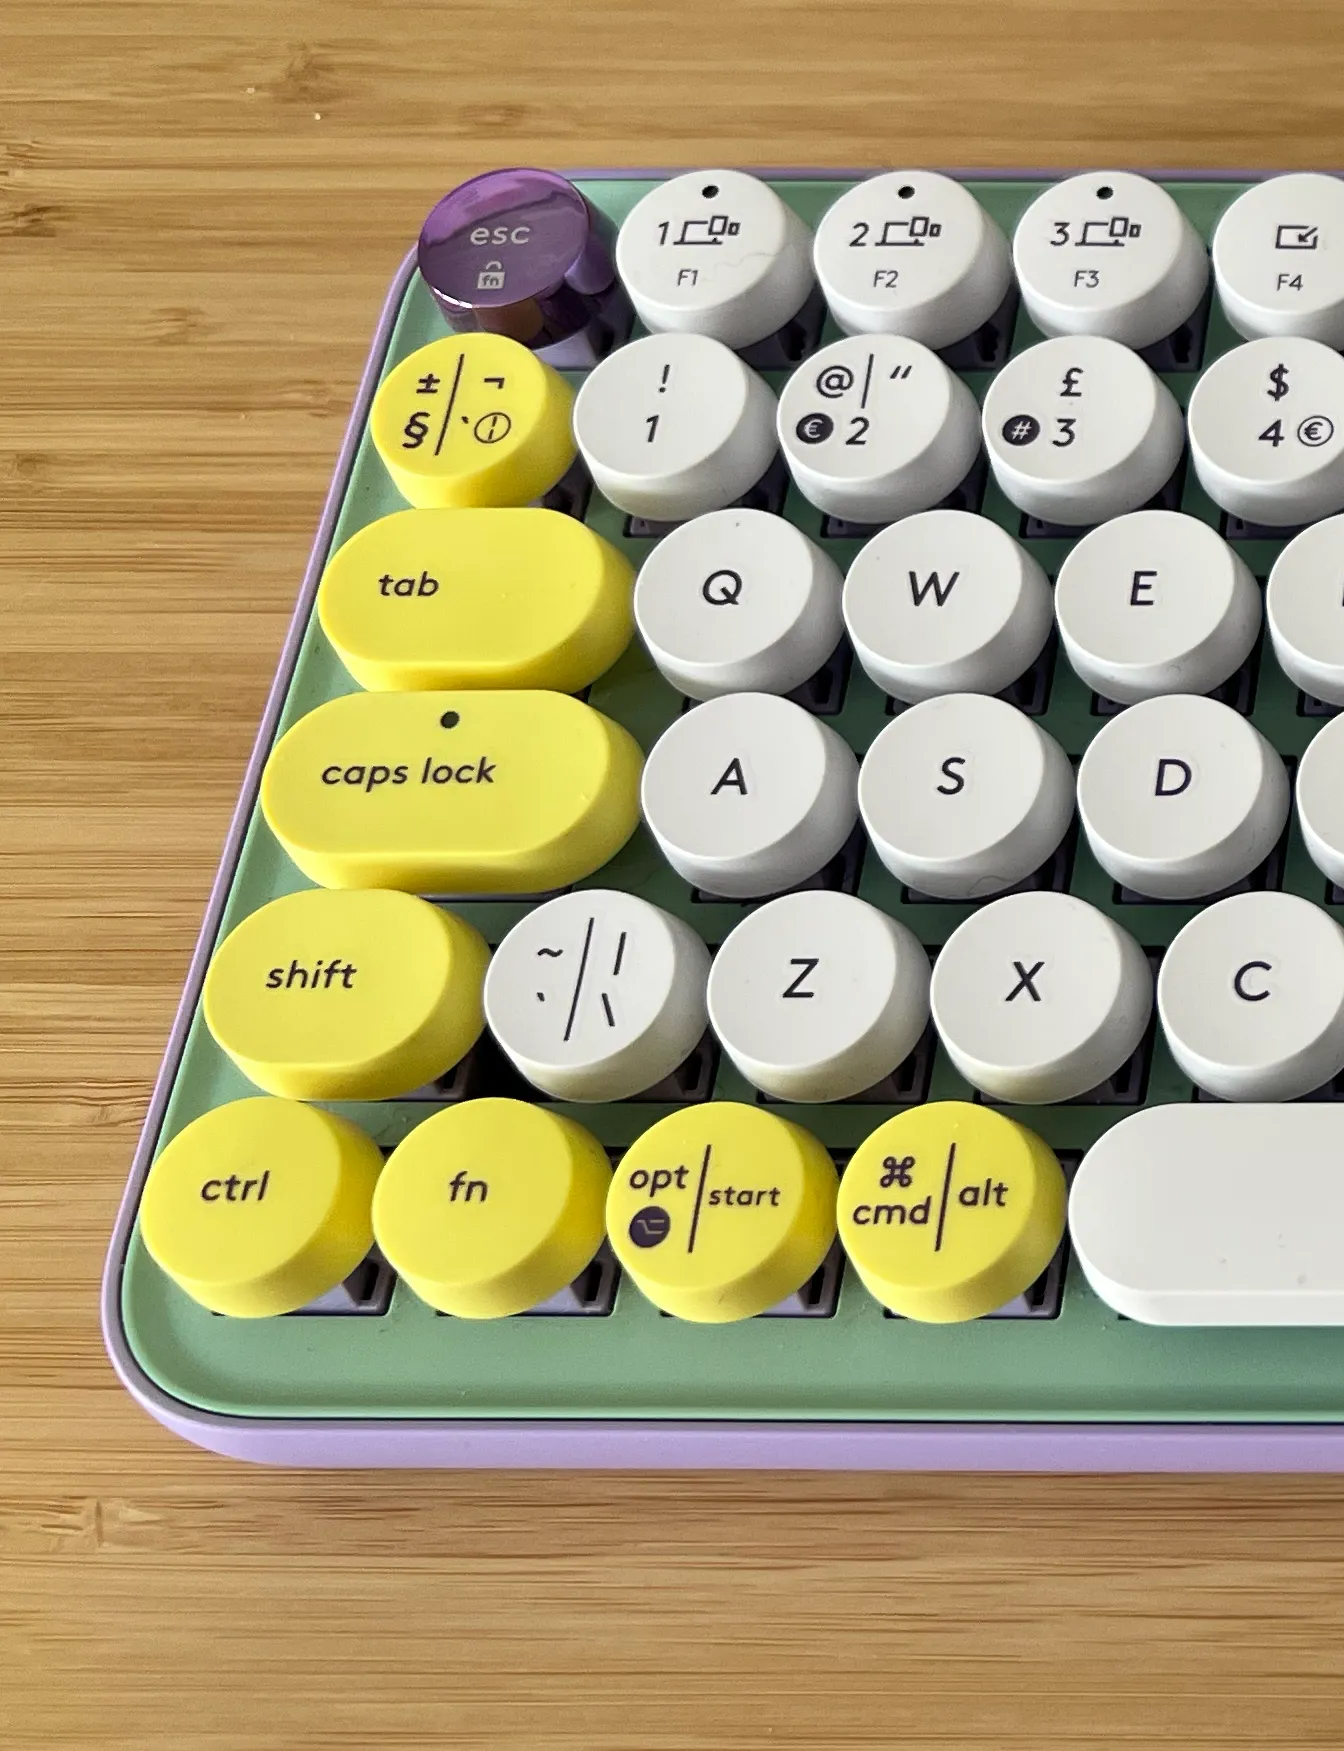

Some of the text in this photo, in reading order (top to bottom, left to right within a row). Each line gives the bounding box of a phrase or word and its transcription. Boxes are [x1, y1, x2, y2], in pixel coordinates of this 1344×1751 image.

[470, 226, 530, 246] esc
[658, 221, 670, 246] 1
[848, 222, 870, 247] 2
[1049, 221, 1070, 247] 3
[481, 273, 500, 287] fn
[677, 268, 699, 287] F1
[873, 269, 899, 289] F2
[1073, 269, 1100, 289] F3
[1276, 273, 1304, 292] F4
[646, 414, 660, 443] 1
[845, 416, 870, 446] 2
[1052, 418, 1077, 448] 3
[1258, 419, 1285, 448] 4
[378, 570, 439, 597] tab
[701, 569, 743, 606] Q
[908, 570, 960, 607] W
[1129, 570, 1158, 607] E
[321, 756, 497, 793] caps lock
[710, 757, 748, 796] A
[936, 756, 966, 796] S
[1154, 758, 1192, 797] D
[265, 959, 358, 989] shift
[782, 958, 820, 999] Z
[1004, 961, 1045, 1002] X
[1233, 960, 1273, 1002] C
[201, 1170, 271, 1202] ctrl
[449, 1170, 488, 1202] fn
[629, 1164, 690, 1198] opt
[958, 1177, 1009, 1207] alt
[708, 1186, 781, 1207] start
[852, 1195, 932, 1226] cmd
